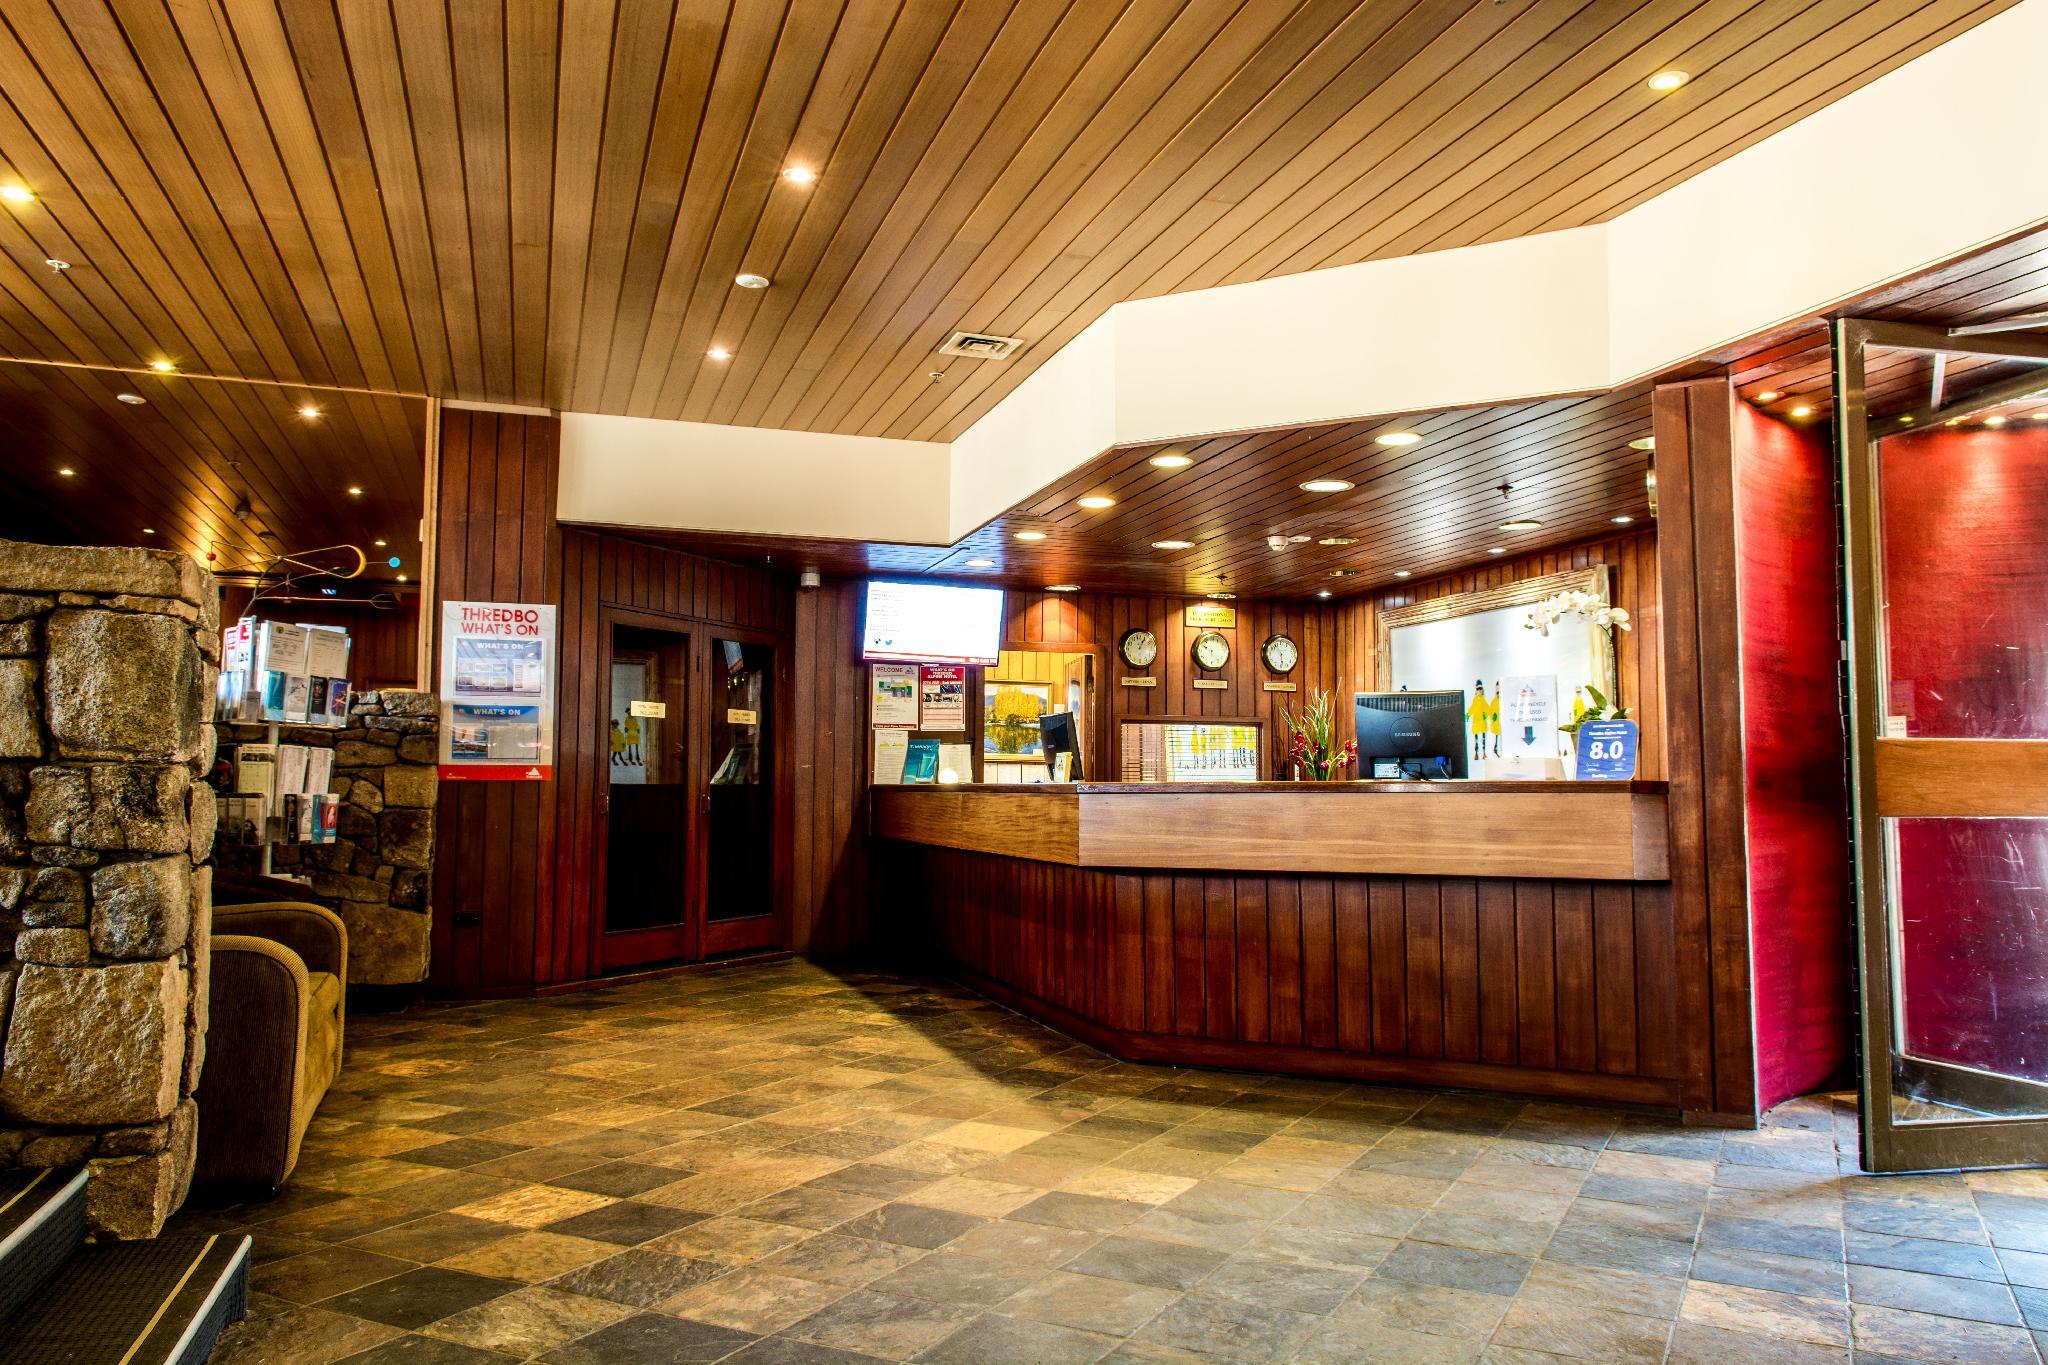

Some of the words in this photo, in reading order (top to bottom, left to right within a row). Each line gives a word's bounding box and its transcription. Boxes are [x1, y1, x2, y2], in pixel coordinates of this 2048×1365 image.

[462, 608, 539, 623] THREDBO
[461, 623, 512, 636] WHAT'S
[516, 625, 539, 636] ON
[473, 708, 506, 716] WHAT'S
[1589, 741, 1624, 759] 8.0
